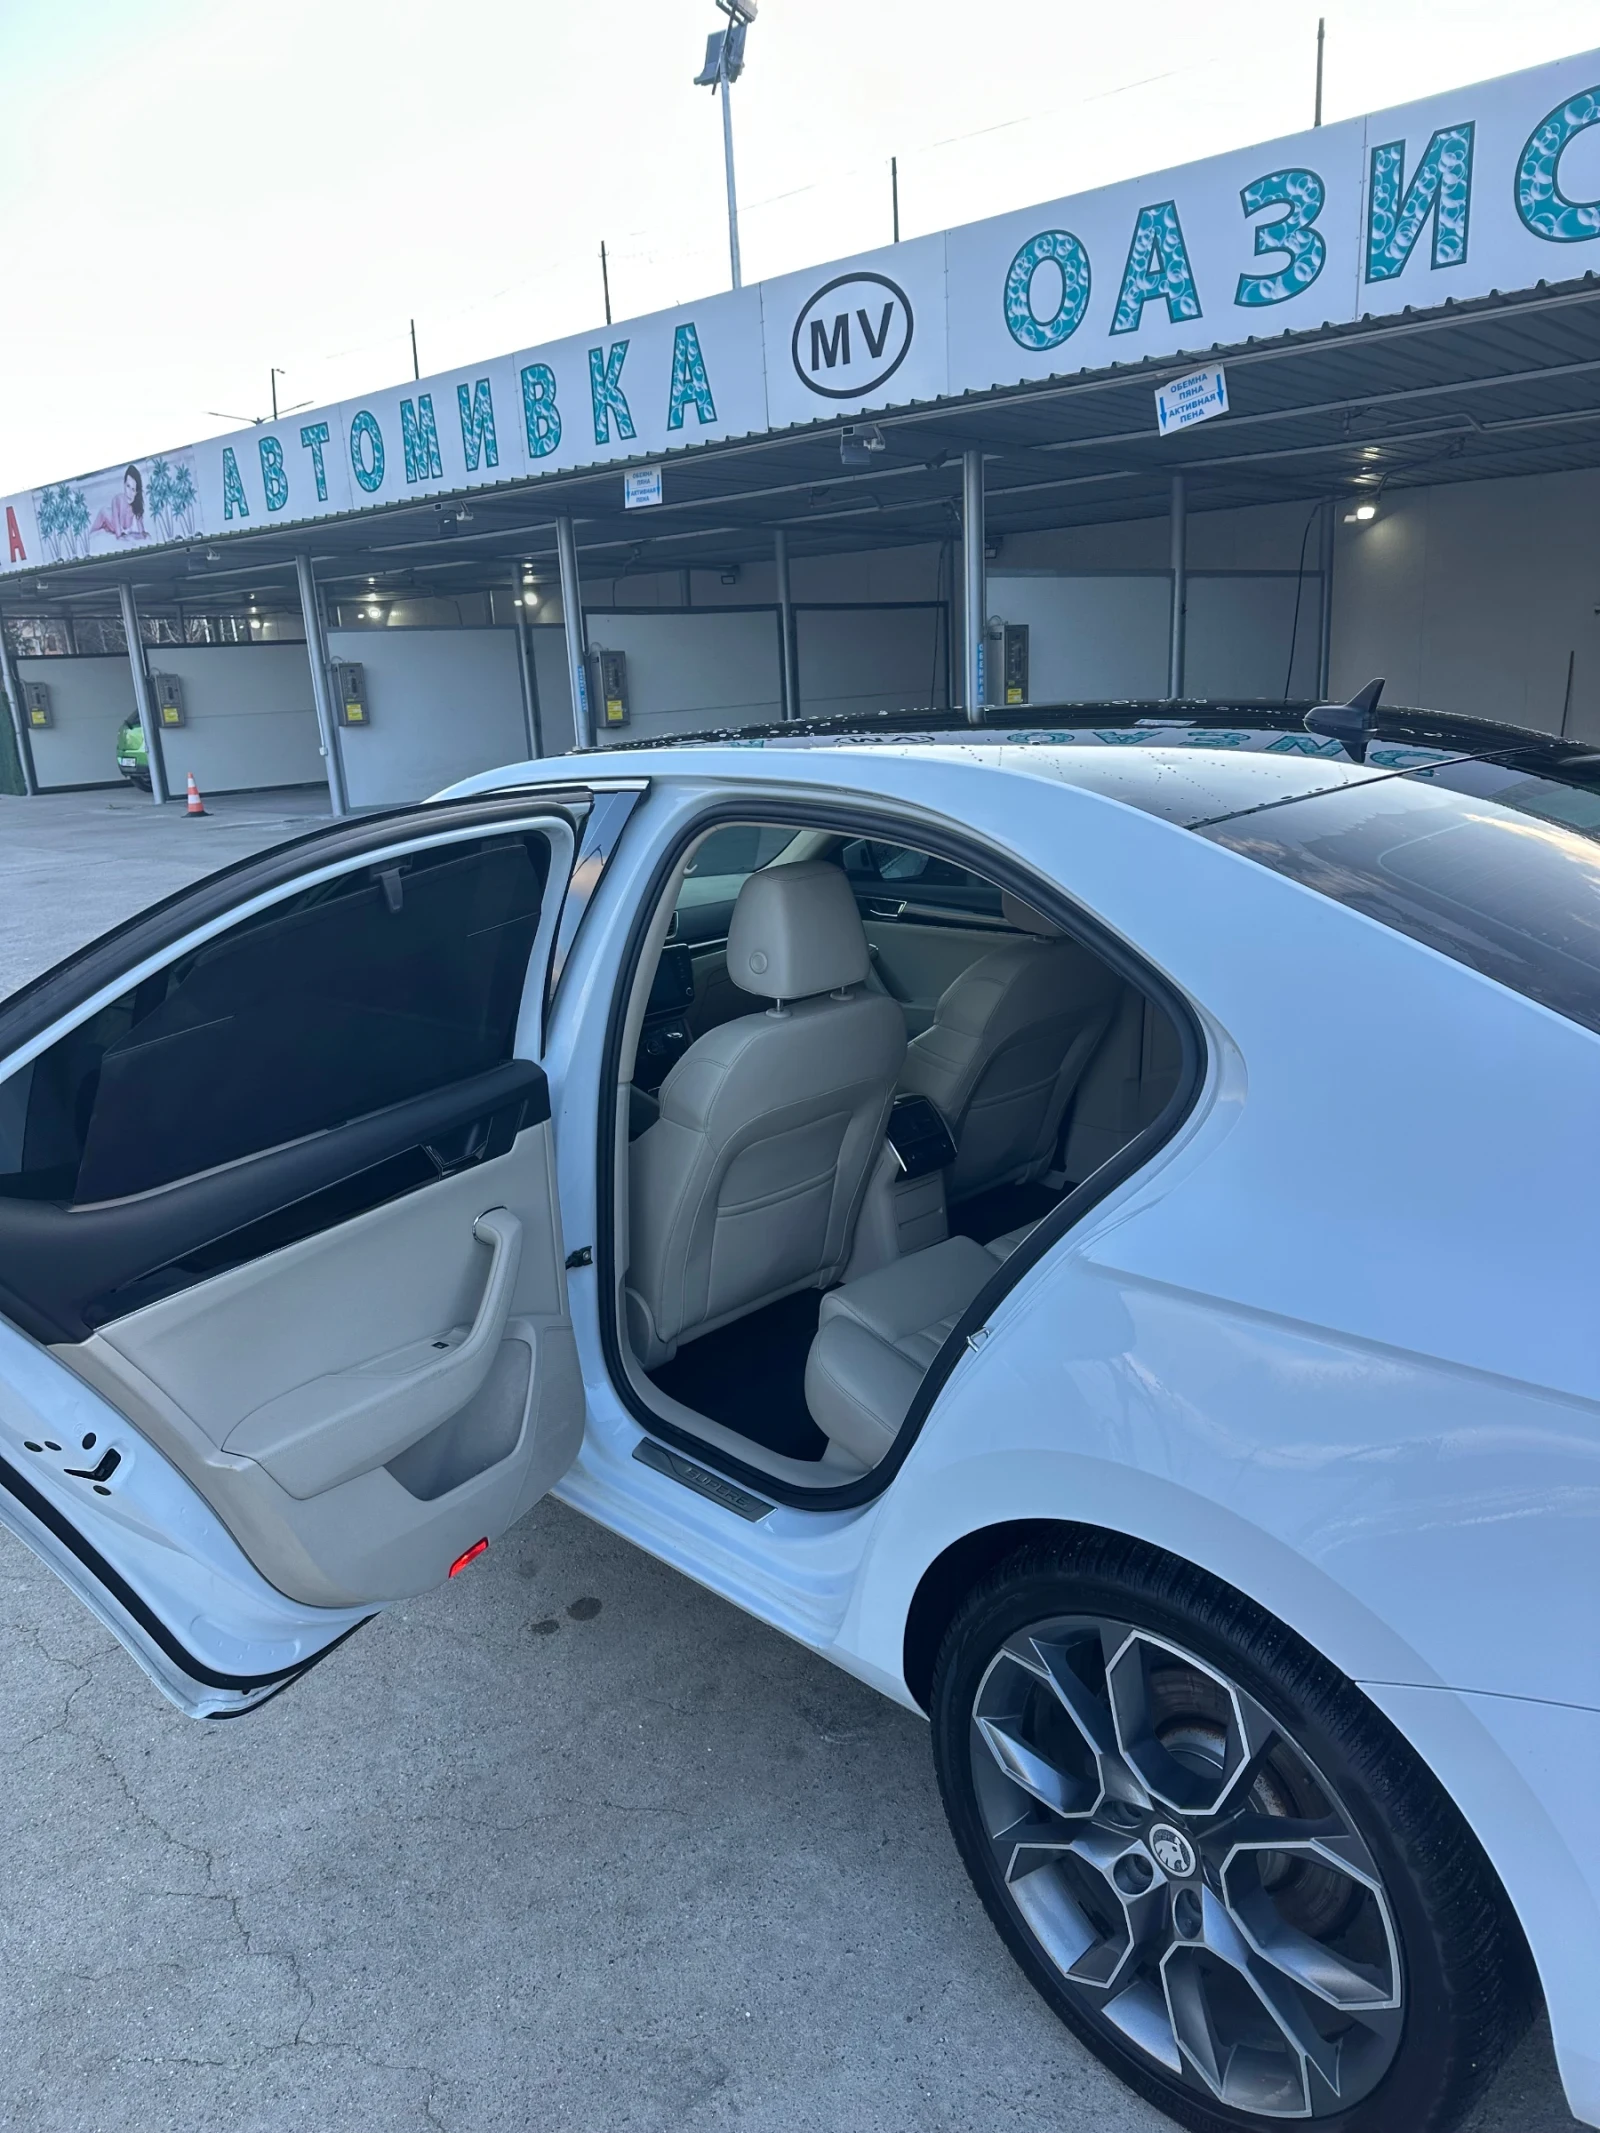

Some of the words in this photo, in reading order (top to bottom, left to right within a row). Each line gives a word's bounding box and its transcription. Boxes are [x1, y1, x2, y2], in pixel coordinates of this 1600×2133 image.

[1003, 84, 1600, 352] ОАЗИС
[811, 301, 895, 371] MV
[1170, 373, 1208, 393] ОБЕМНА
[1178, 385, 1204, 400] ПЯНА
[1168, 393, 1216, 418] АКТИВНАЯ
[1180, 408, 1205, 423] ПЕНА
[222, 322, 717, 521] АВТОМИВКА
